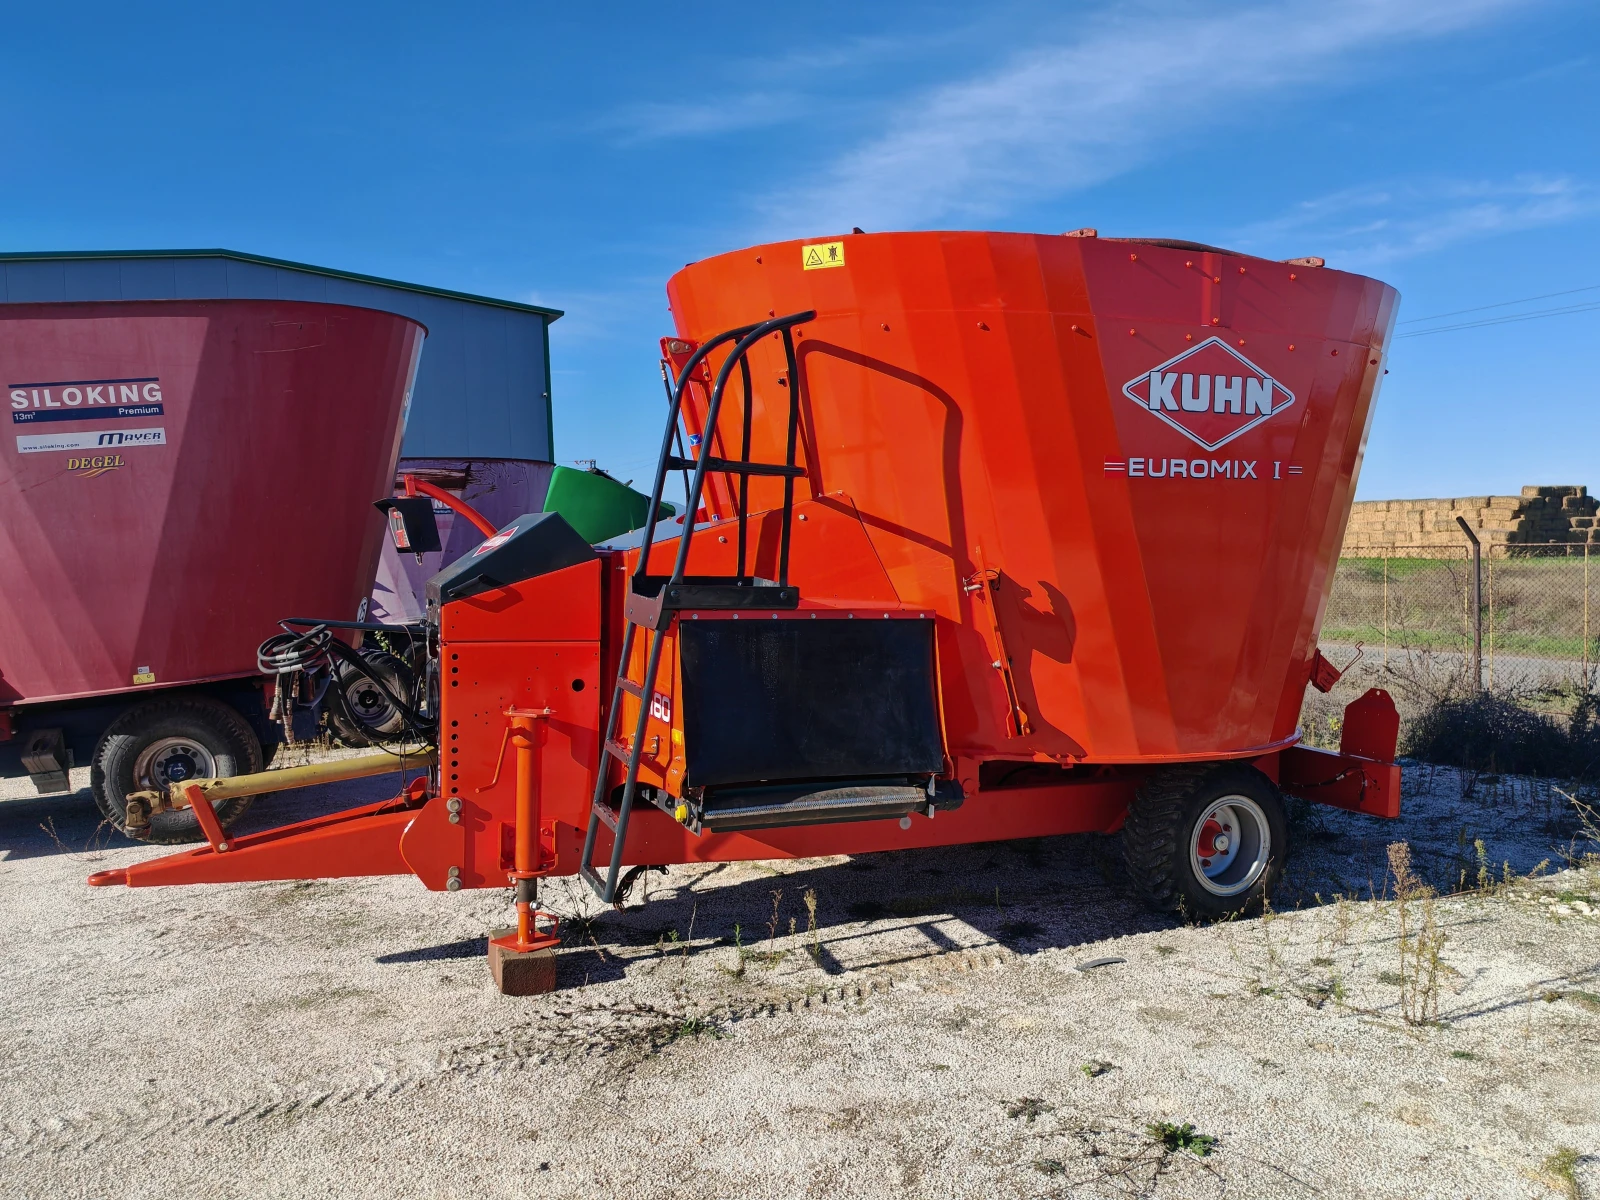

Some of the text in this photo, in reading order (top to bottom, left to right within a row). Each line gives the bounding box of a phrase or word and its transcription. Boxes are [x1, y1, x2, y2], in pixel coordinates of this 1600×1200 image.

[10, 383, 163, 409] SILOKING
[1149, 371, 1273, 415] KUHN
[118, 406, 160, 415] Premium
[98, 432, 161, 445] MAYER
[67, 455, 126, 470] DEGEL
[1128, 457, 1282, 480] EUROMIX I
